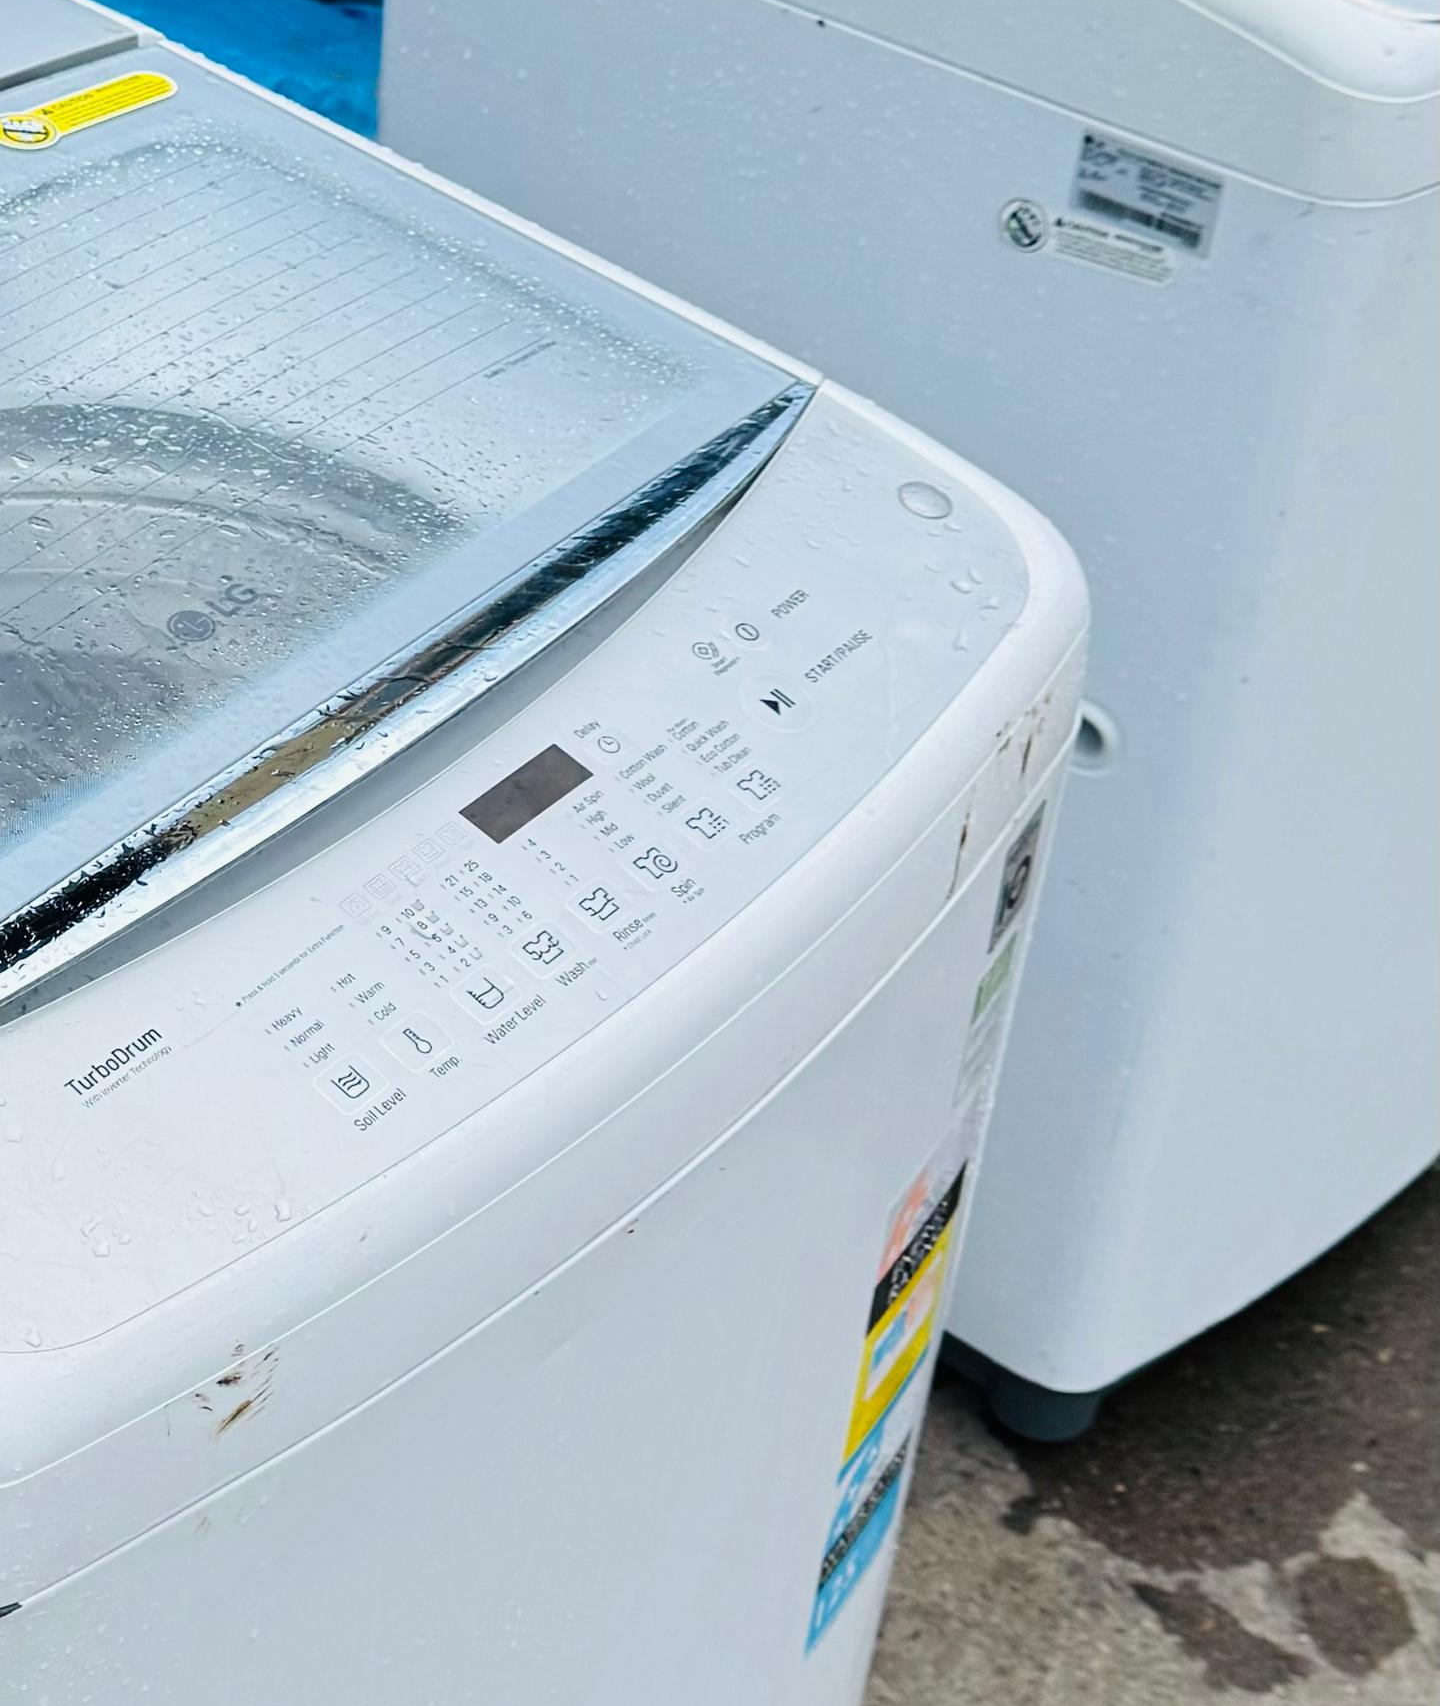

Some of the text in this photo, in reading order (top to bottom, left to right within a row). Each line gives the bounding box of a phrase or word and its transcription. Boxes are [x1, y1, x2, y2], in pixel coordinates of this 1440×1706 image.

[204, 583, 259, 617] LG
[770, 589, 810, 619] POWER
[804, 629, 874, 683] START/PAUSE
[739, 813, 781, 845] Program
[614, 834, 635, 849] Low
[464, 859, 479, 873] 25
[554, 862, 566, 872] 2
[445, 874, 459, 887] 21
[478, 871, 493, 883] 18
[460, 886, 474, 898] 15
[492, 884, 507, 895] 14
[671, 878, 696, 897] Spin
[474, 898, 488, 909] 13
[507, 896, 522, 907] 10
[401, 908, 415, 919] 10
[488, 912, 499, 923] 9
[522, 910, 533, 920] 6
[381, 925, 392, 935] 9
[417, 920, 428, 930] 8
[502, 925, 513, 935] 3
[613, 919, 644, 942] Rinse
[395, 937, 405, 947] 7
[432, 933, 442, 943] 6
[409, 949, 421, 960] 5
[447, 945, 456, 954] 4
[424, 962, 435, 972] 3
[460, 958, 471, 968] 2
[555, 960, 590, 987] Wash
[336, 973, 356, 989] Hot
[355, 981, 385, 1004] Warm
[373, 1002, 397, 1021] Cold
[271, 1006, 303, 1031] Heavy
[483, 994, 547, 1044] Water Level
[290, 1019, 325, 1047] Normal
[309, 1043, 336, 1065] Light
[63, 1028, 163, 1096] TurboDrum
[428, 1055, 463, 1078] Temp.
[353, 1088, 407, 1131] Soil Level
